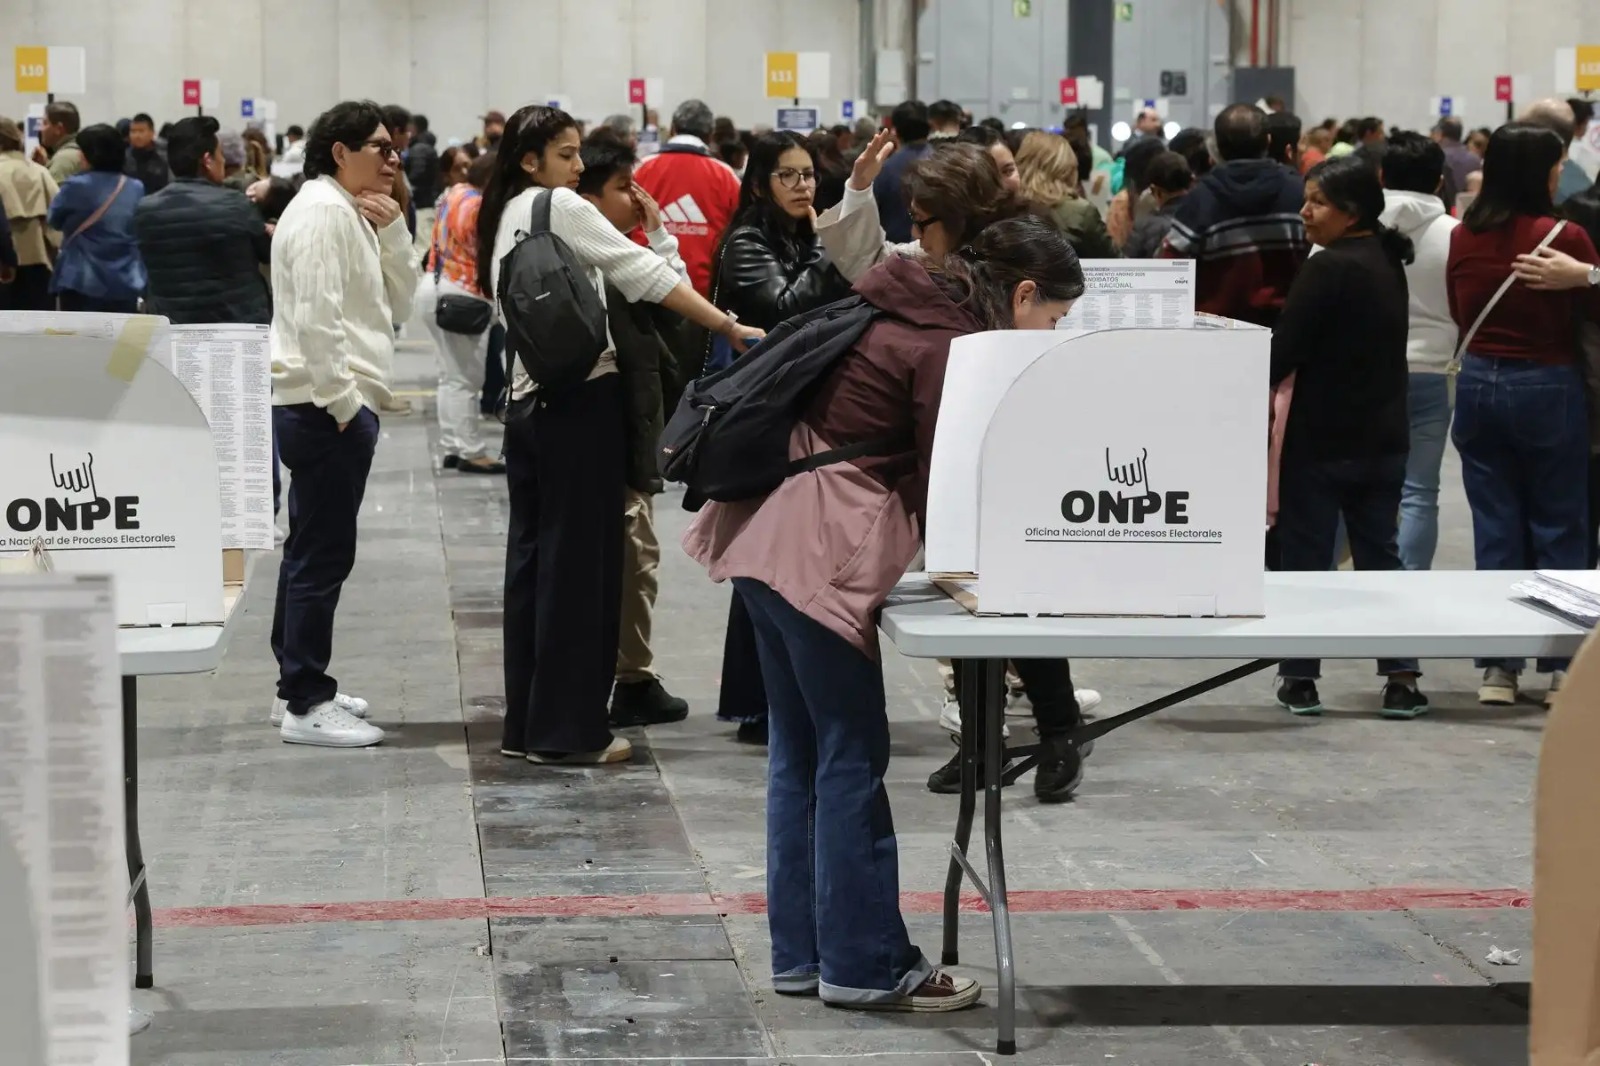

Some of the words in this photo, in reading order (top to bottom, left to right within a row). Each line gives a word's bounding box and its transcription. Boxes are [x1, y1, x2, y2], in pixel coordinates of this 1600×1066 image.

[771, 70, 792, 82] 111
[665, 222, 708, 235] didas
[1061, 490, 1190, 524] ONPE
[6, 496, 140, 531] ONPE
[1024, 527, 1060, 537] Oficina
[1062, 528, 1106, 537] Nacional
[1108, 528, 1121, 537] de
[1123, 528, 1167, 538] Procesos
[1169, 528, 1223, 538] Electorales
[9, 536, 54, 546] Nacioal
[56, 536, 71, 545] de
[73, 535, 118, 544] Procesos
[121, 534, 176, 543] Electorales
